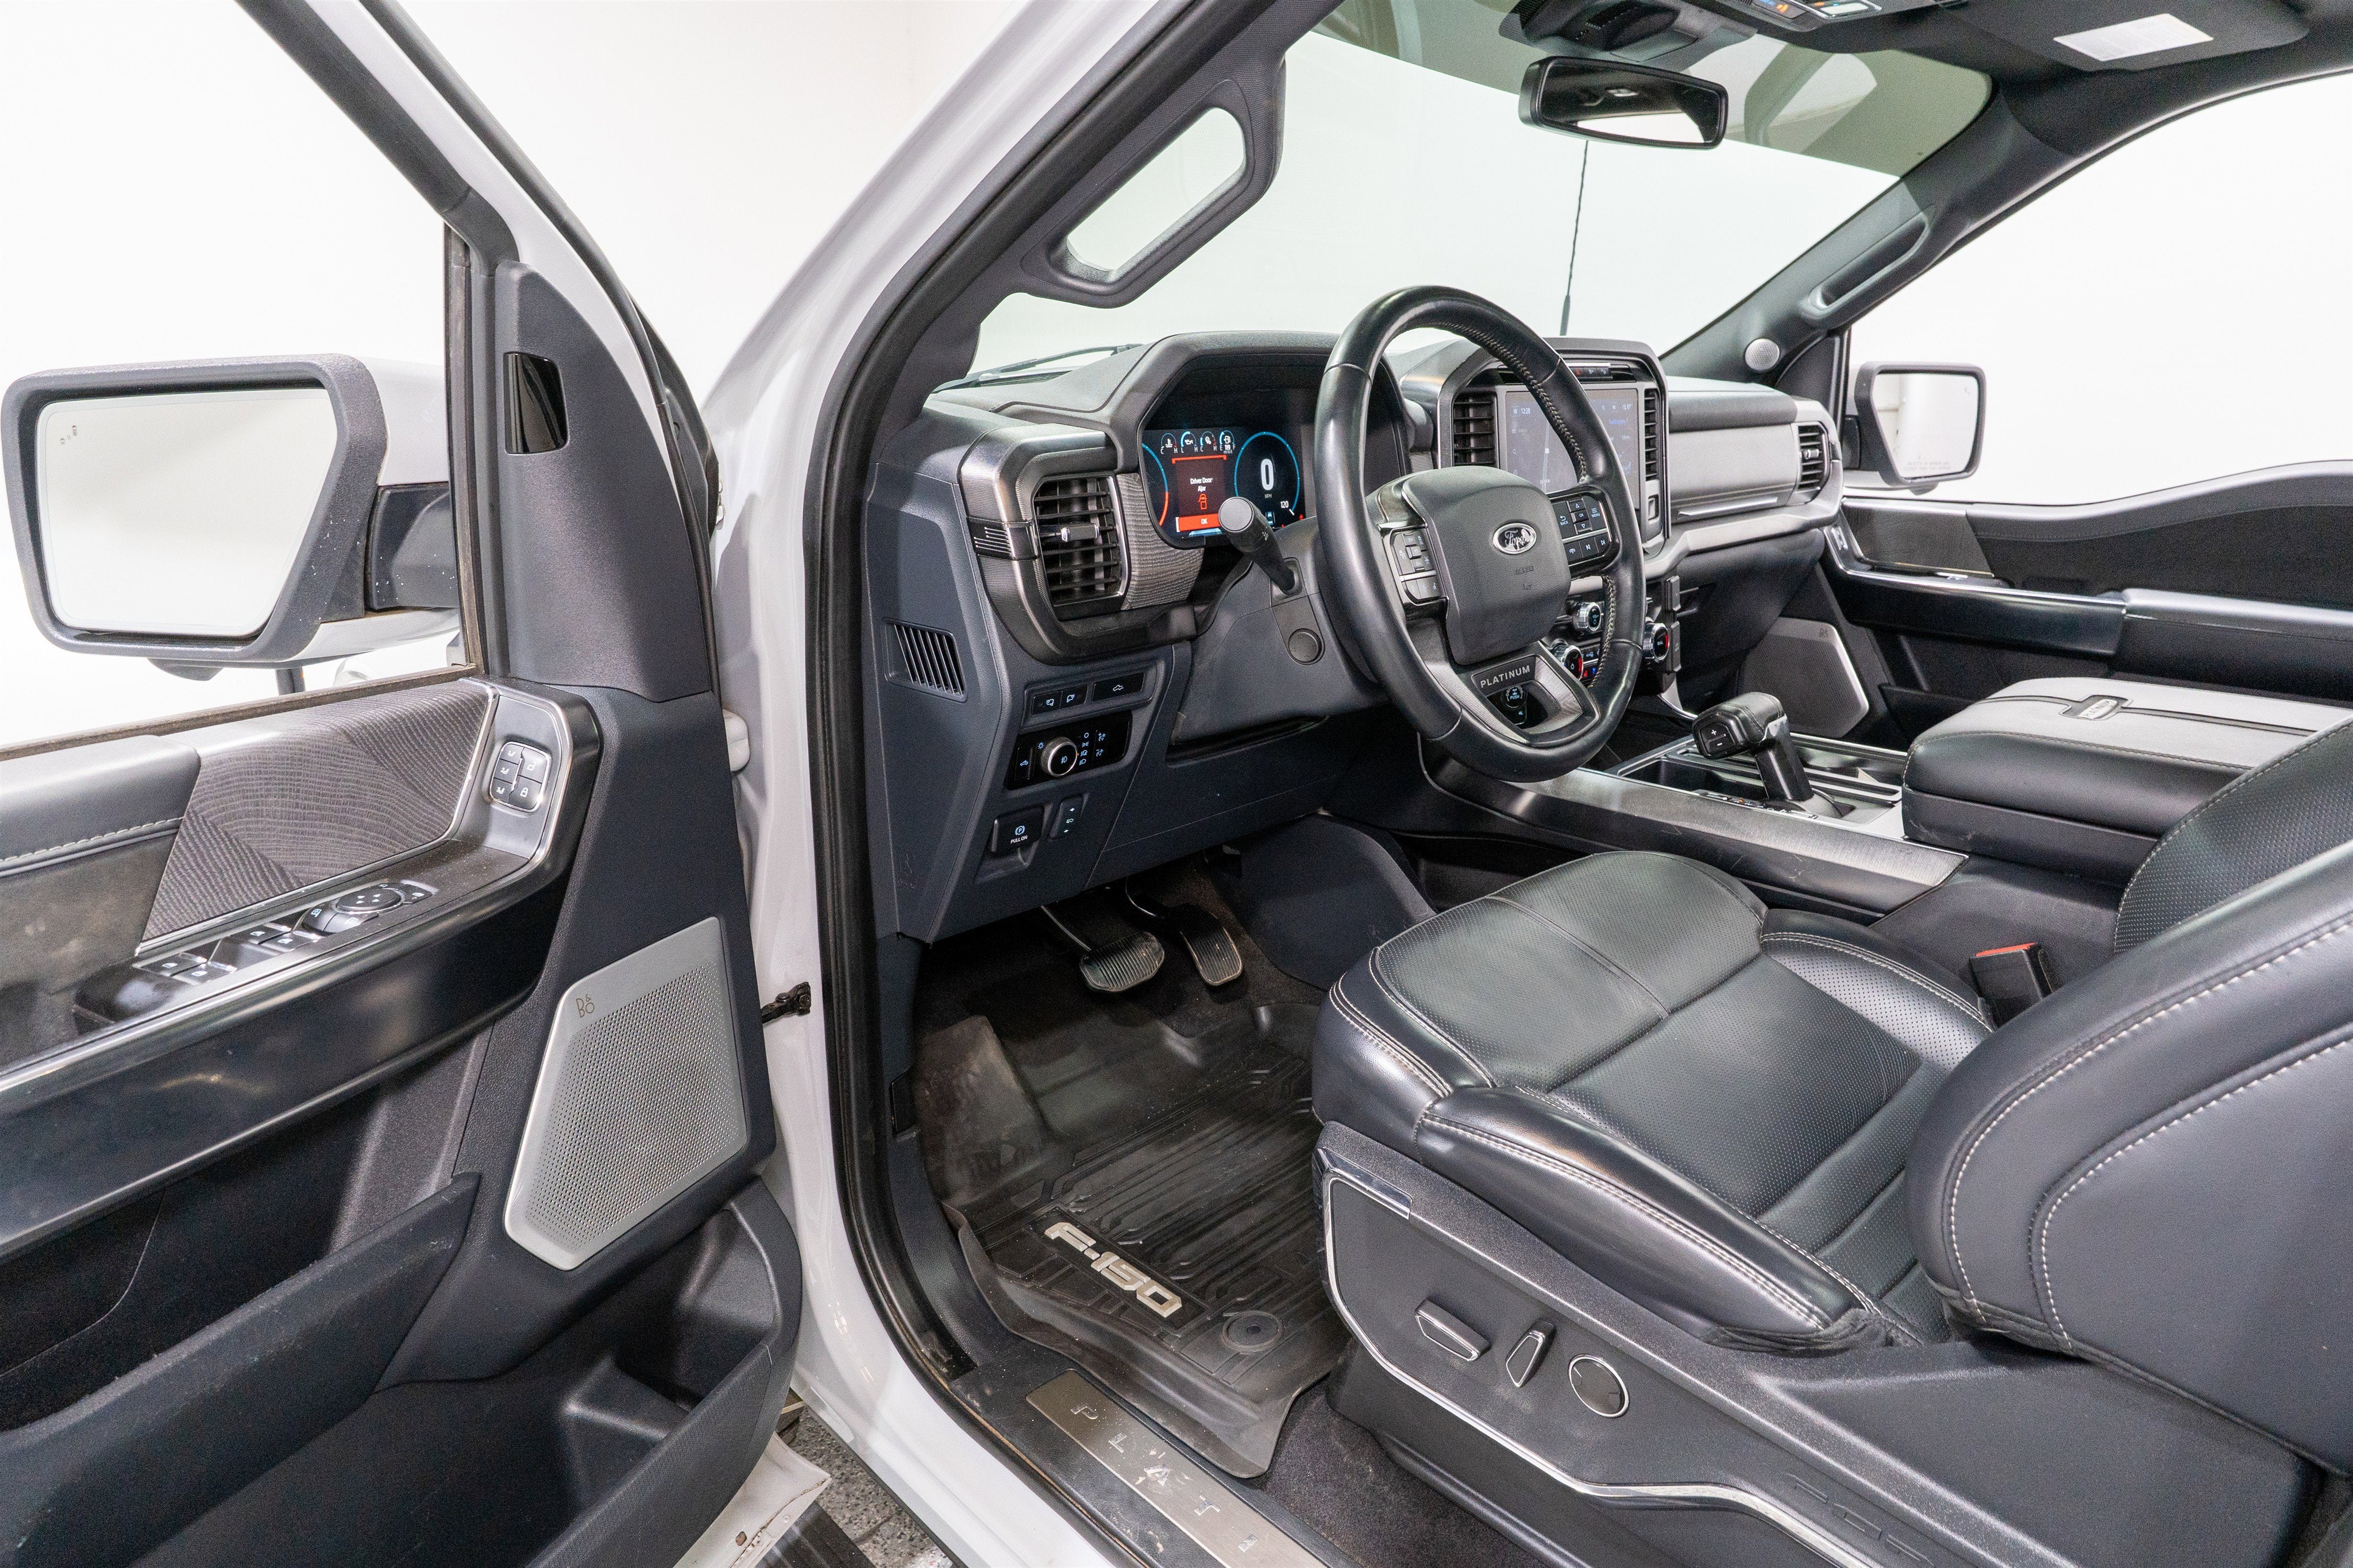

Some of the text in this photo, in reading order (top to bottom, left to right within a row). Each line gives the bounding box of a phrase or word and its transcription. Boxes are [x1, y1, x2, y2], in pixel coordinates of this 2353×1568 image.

[1260, 459, 1274, 491] 0
[1280, 500, 1289, 508] 120
[1505, 529, 1530, 550] Ford
[1480, 665, 1530, 688] PLATINUM
[1044, 1222, 1182, 1318] F-150
